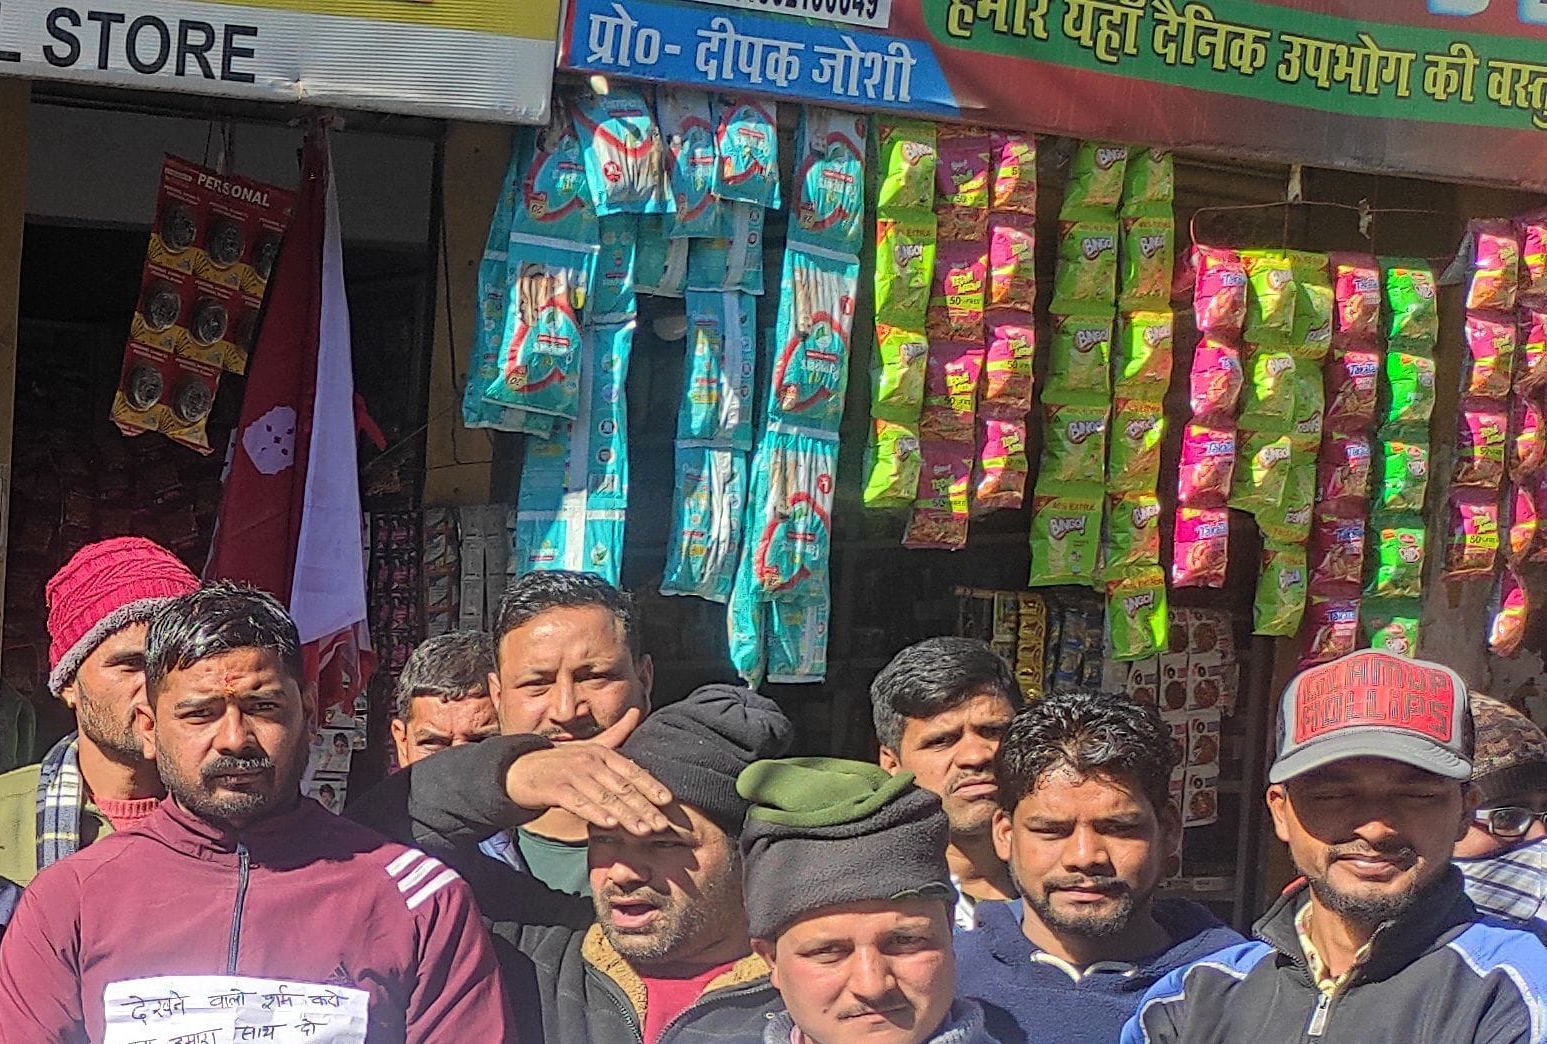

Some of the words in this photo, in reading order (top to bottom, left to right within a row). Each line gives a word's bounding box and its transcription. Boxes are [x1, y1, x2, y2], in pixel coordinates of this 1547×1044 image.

[42, 7, 258, 83] STORE
[695, 16, 805, 87] दीपक
[812, 35, 917, 103] जोशी
[1154, 2, 1271, 74] दैनिक
[1277, 33, 1416, 97] उपभोग
[1424, 43, 1480, 102] की
[197, 173, 270, 208] PERSONAL
[261, 985, 305, 1013] शर्म
[306, 989, 349, 1009] करो
